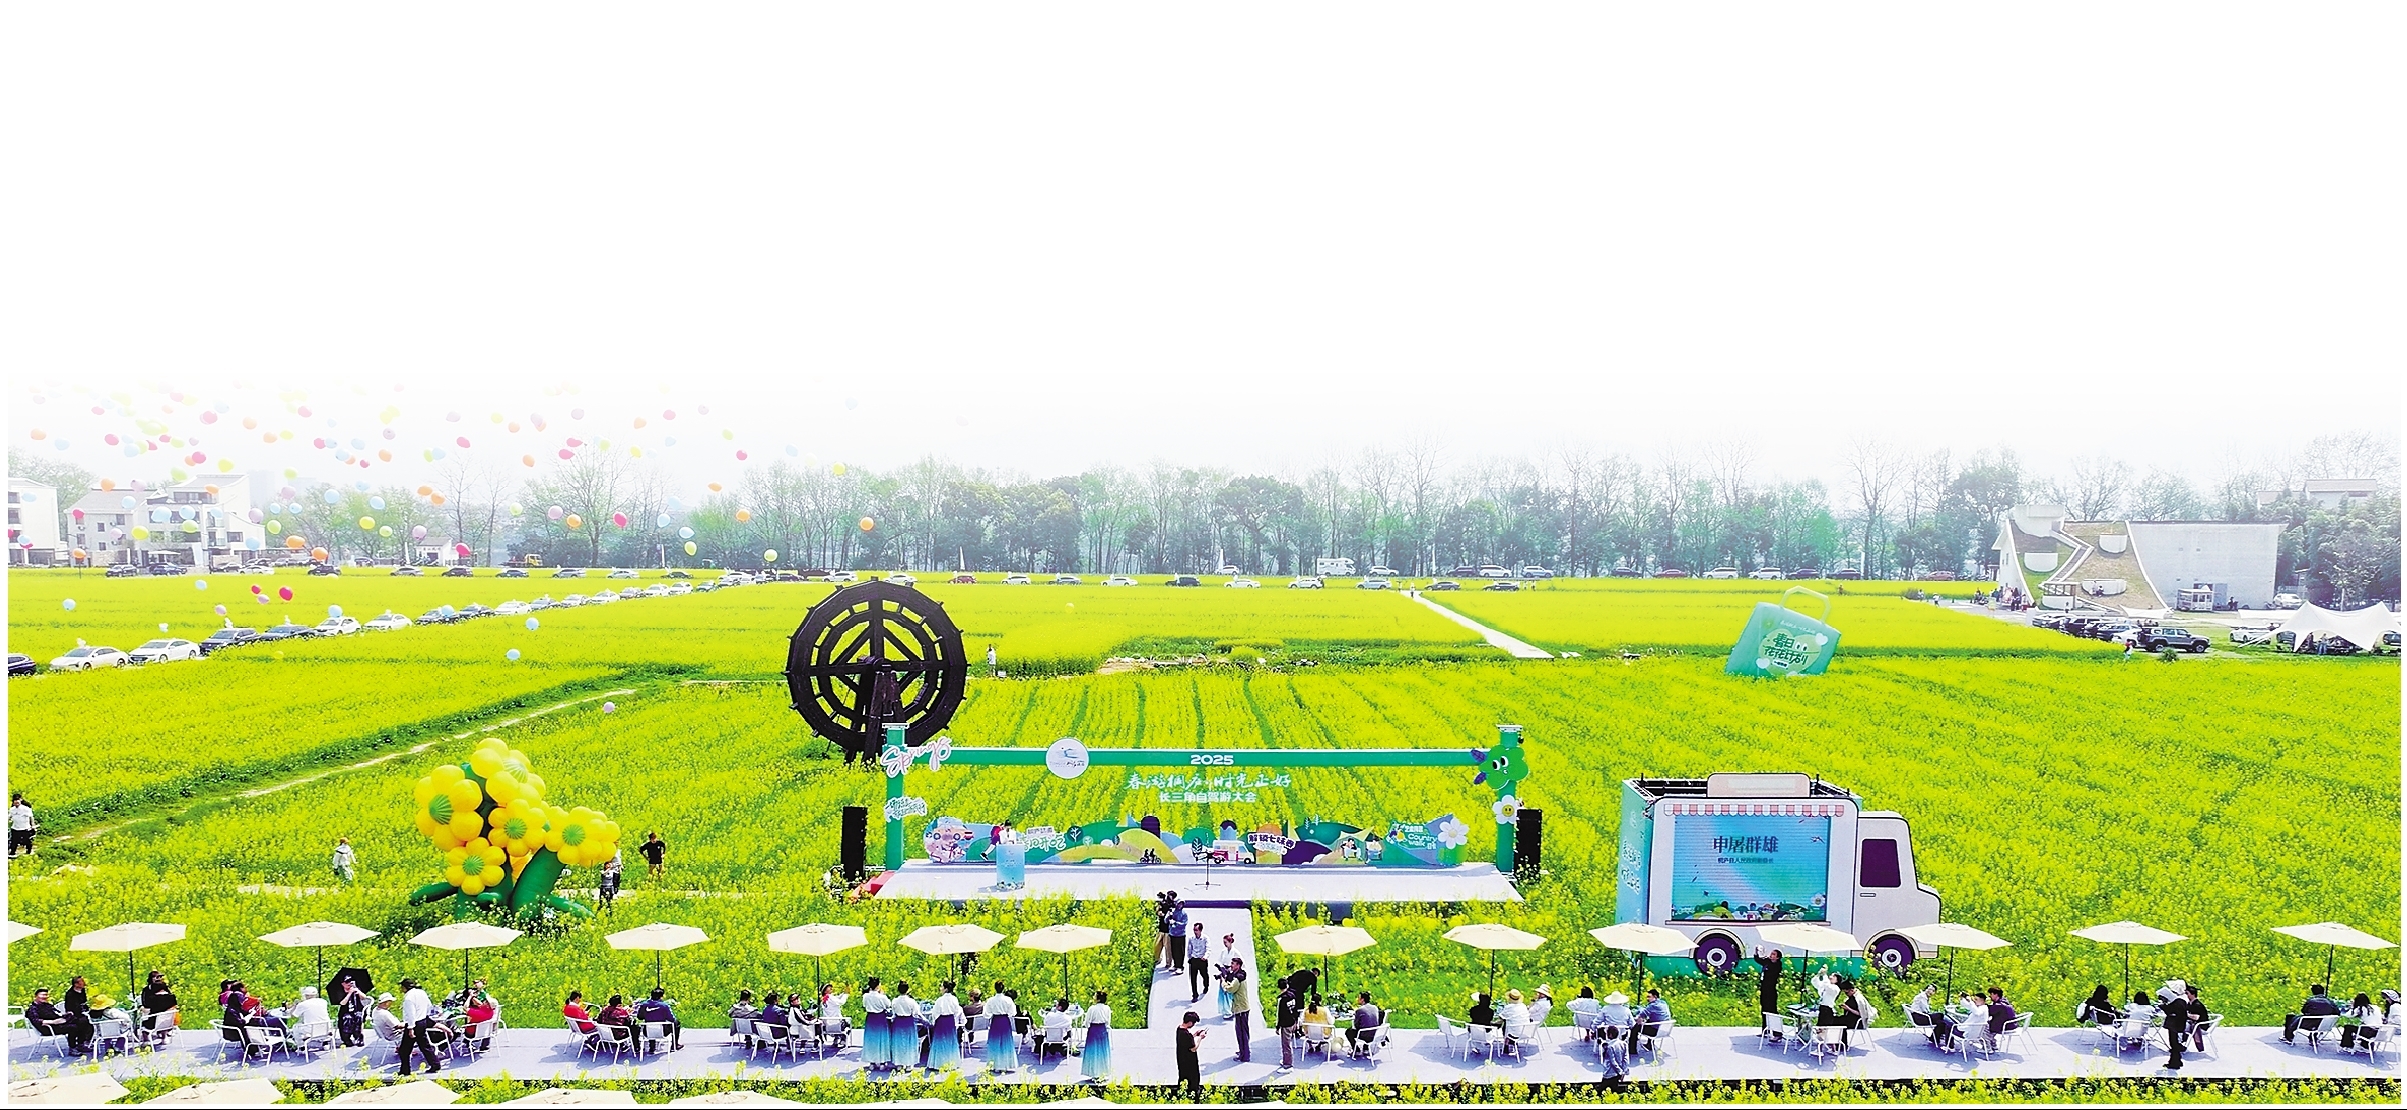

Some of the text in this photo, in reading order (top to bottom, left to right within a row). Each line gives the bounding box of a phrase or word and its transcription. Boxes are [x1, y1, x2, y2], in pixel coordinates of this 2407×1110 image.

[1773, 633, 1795, 648] 春日
[1190, 754, 1234, 765] 2025
[1159, 791, 1257, 803] 长三角自驾游大会
[1408, 833, 1438, 843] Country
[1713, 835, 1779, 854] 申屠群雄
